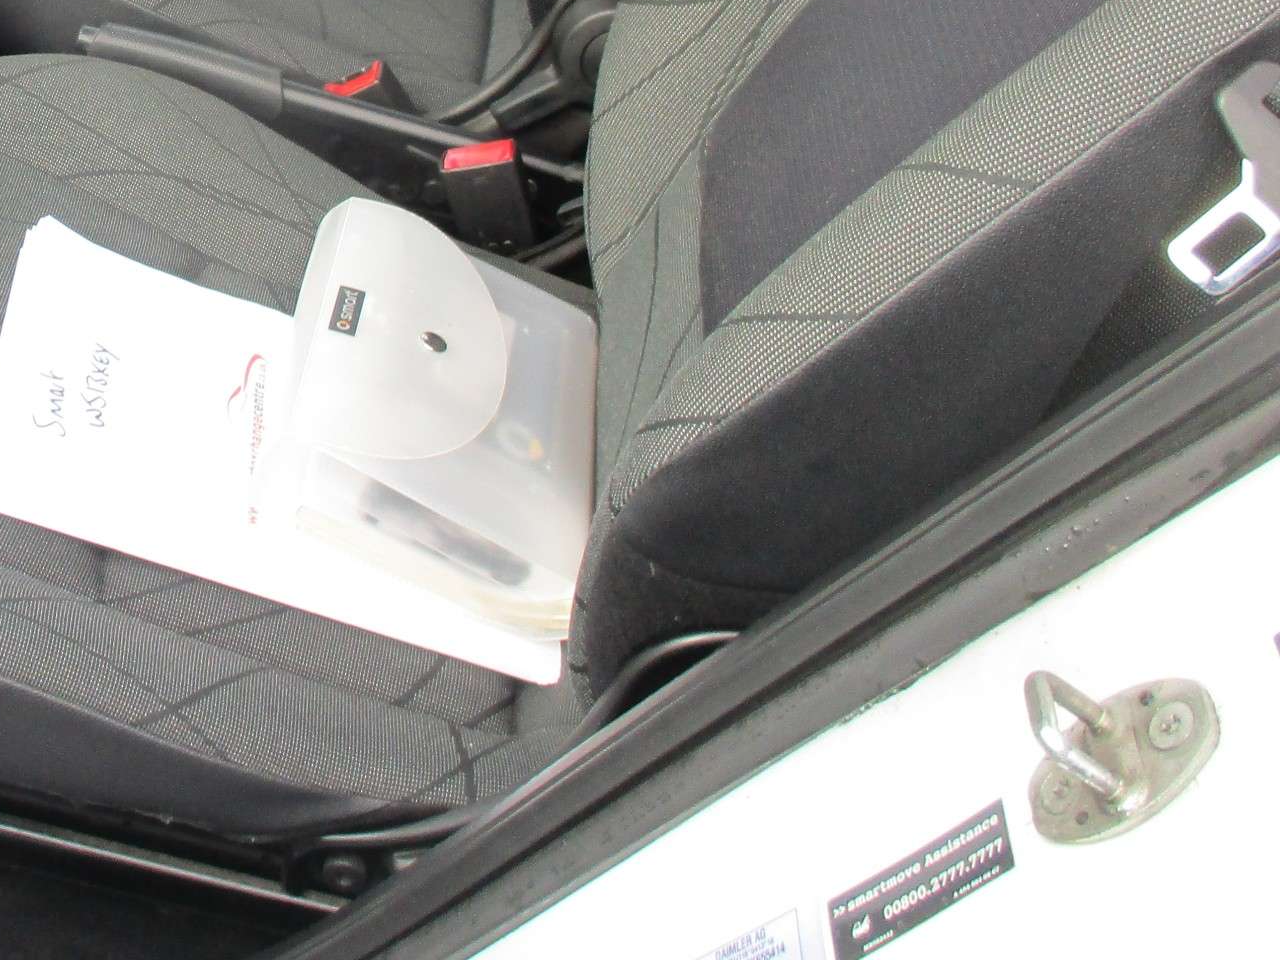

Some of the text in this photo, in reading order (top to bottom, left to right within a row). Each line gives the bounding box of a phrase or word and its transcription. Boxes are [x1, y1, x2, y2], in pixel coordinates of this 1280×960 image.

[339, 289, 360, 321] smart
[847, 861, 922, 913] smartmove
[923, 813, 999, 869] Assistance
[883, 837, 1003, 920] 00800.2777.7777
